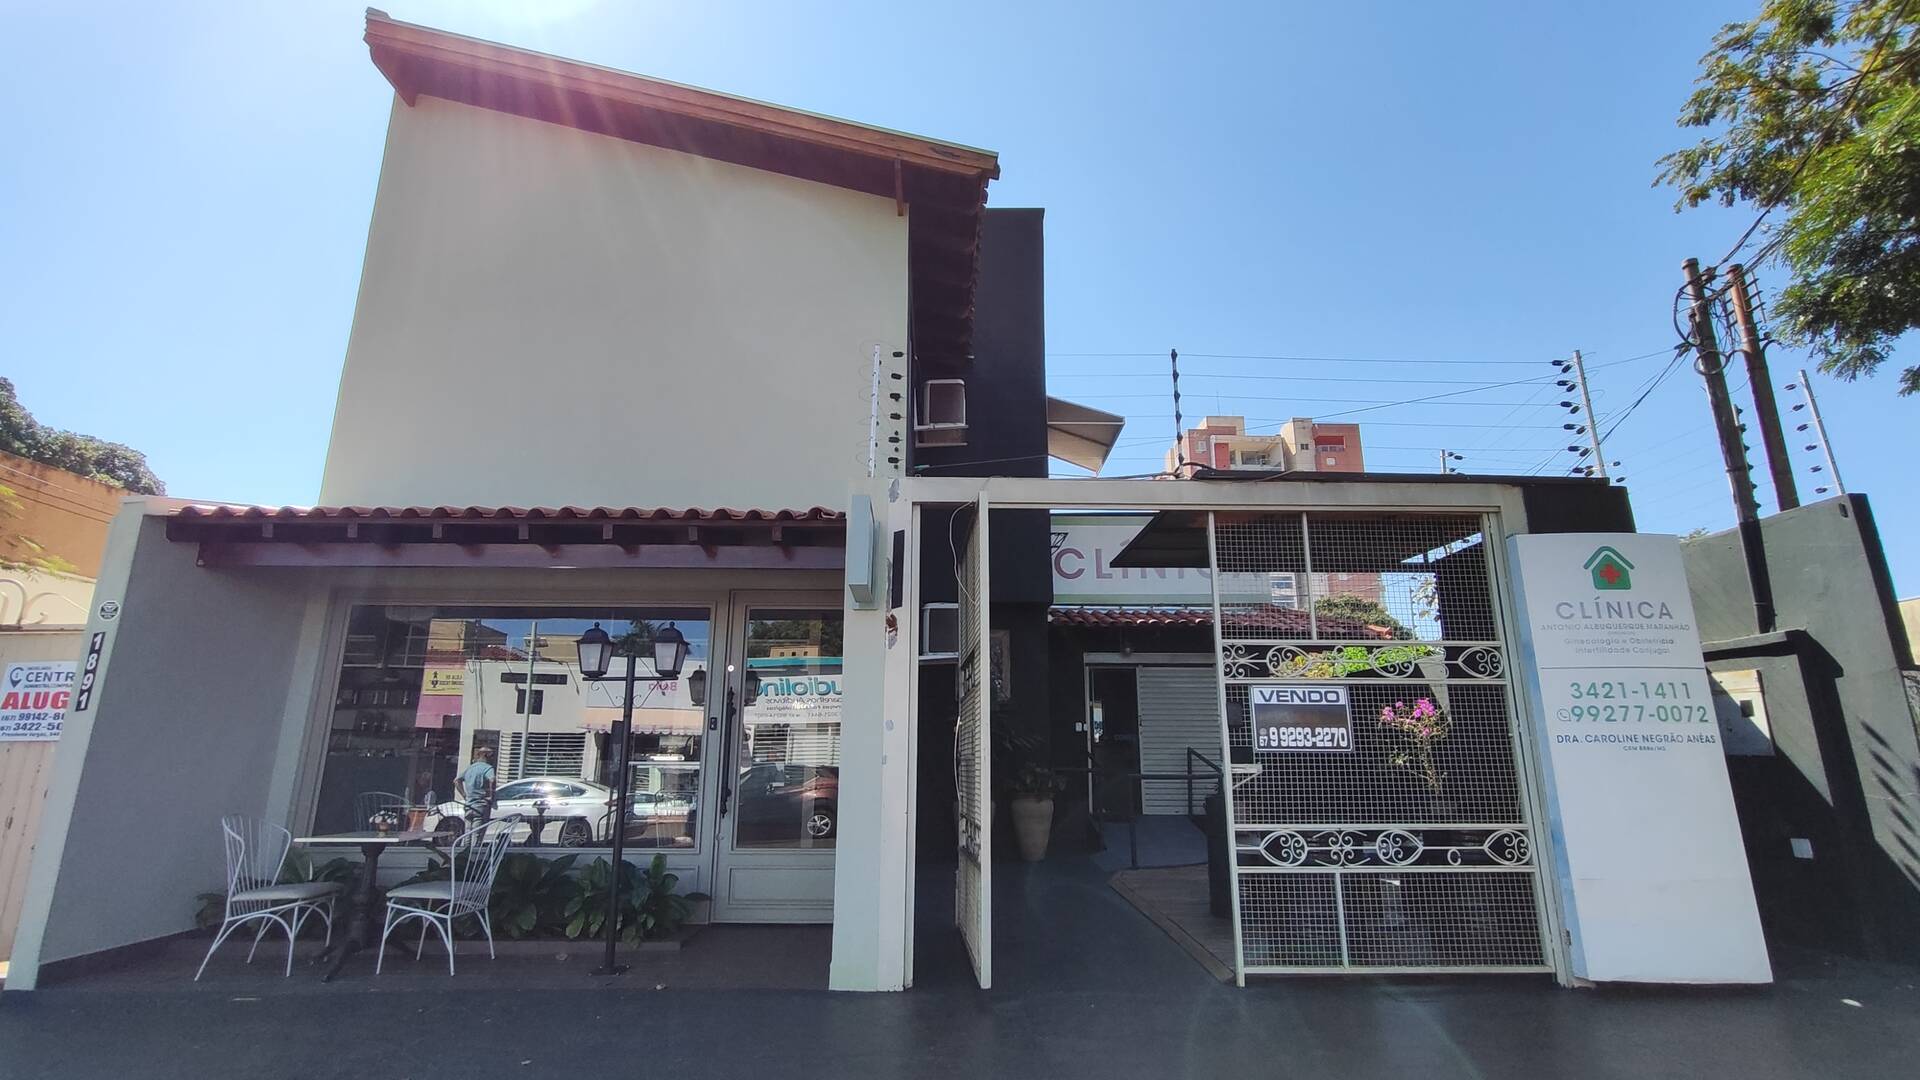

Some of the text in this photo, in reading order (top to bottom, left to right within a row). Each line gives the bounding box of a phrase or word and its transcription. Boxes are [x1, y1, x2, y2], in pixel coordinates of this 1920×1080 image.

[1556, 597, 1674, 620] CLÍNICA
[26, 671, 76, 682] CENTR
[79, 634, 102, 710] 1891
[1258, 690, 1340, 702] VENDO
[1570, 682, 1692, 700] 3421-1411
[1, 691, 70, 710] ALUG
[1571, 706, 1709, 723] 99277-0072
[1259, 736, 1268, 747] 67
[1279, 727, 1348, 747] 9293-2270
[1556, 735, 1582, 744] DRA.
[1584, 734, 1640, 744] CAROLINE
[1642, 732, 1684, 744] NEGRÃO
